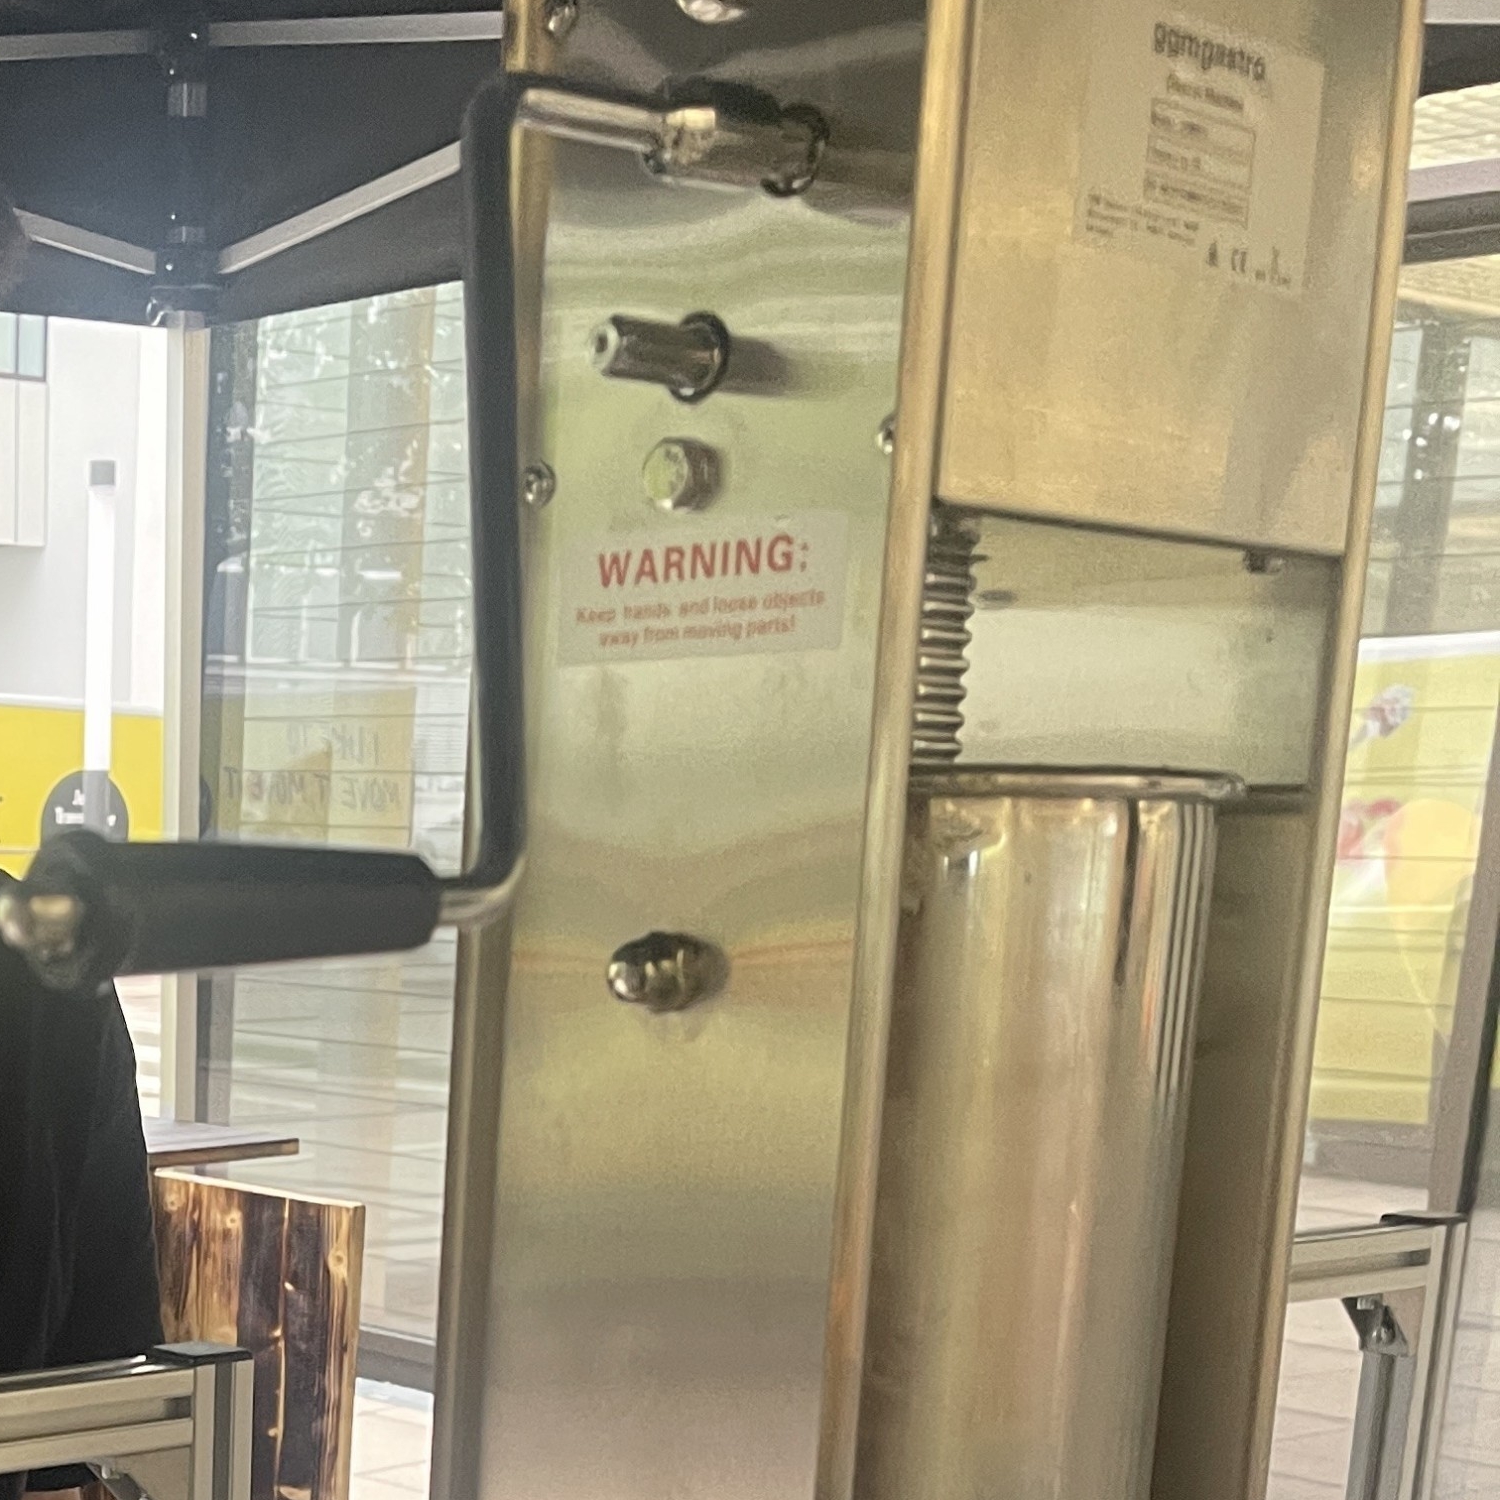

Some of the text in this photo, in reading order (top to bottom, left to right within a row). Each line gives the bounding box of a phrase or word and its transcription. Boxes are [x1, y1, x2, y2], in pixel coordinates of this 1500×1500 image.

[599, 533, 809, 588] WARNING:
[576, 606, 617, 623] Keep
[623, 603, 671, 619] hands
[679, 598, 710, 617] and
[762, 589, 825, 610] objects
[644, 626, 679, 643] from
[683, 621, 743, 641] moving
[747, 614, 795, 638] parts!
